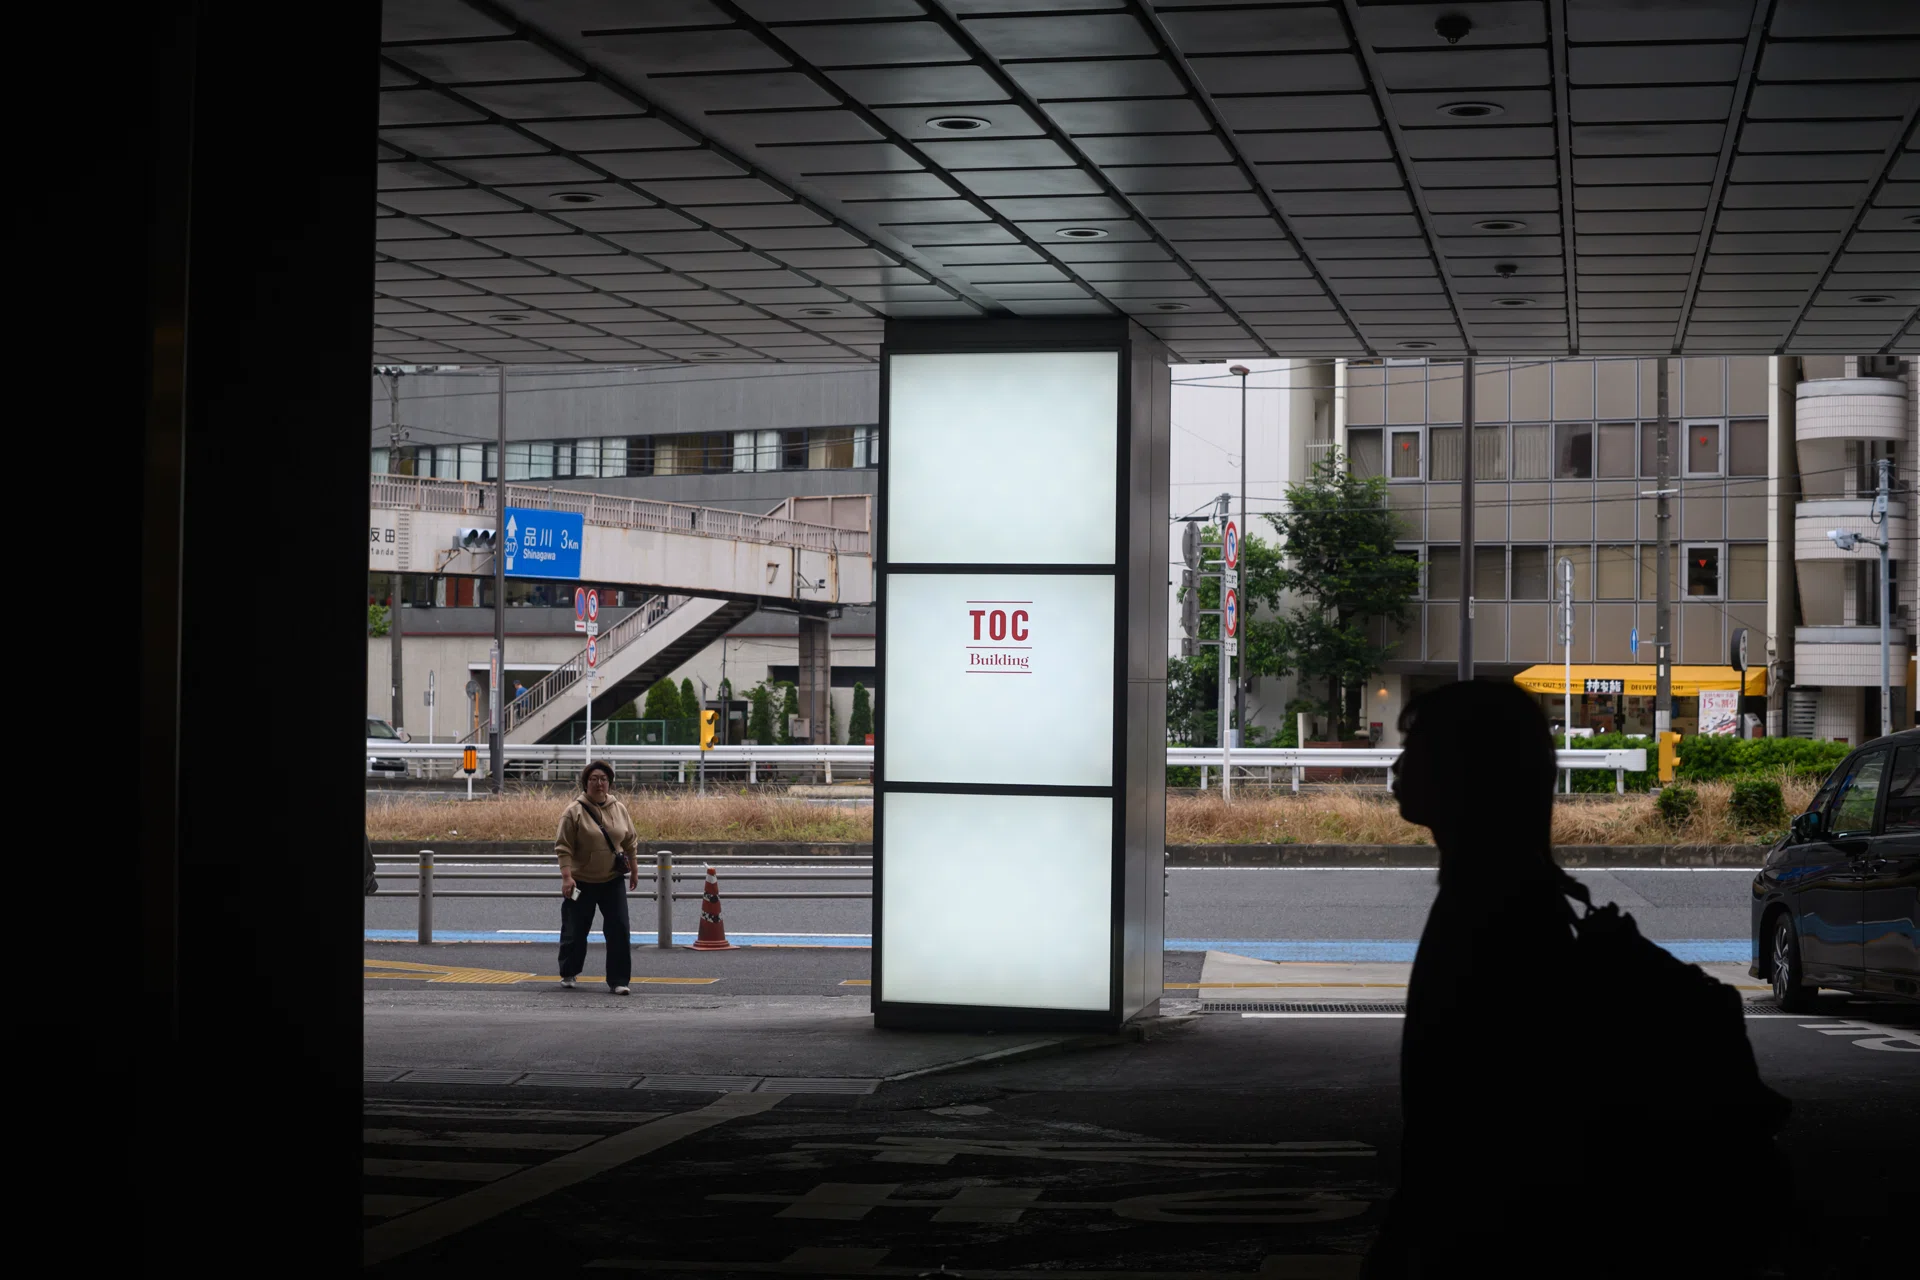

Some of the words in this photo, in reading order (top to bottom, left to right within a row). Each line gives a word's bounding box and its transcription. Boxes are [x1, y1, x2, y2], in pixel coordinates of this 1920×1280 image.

[370, 527, 395, 543] 反田
[524, 527, 552, 547] 品川
[371, 546, 394, 555] tanda
[505, 541, 516, 552] 317
[523, 548, 556, 562] Shinagawa
[969, 610, 1029, 641] TOC
[970, 653, 1030, 669] Building
